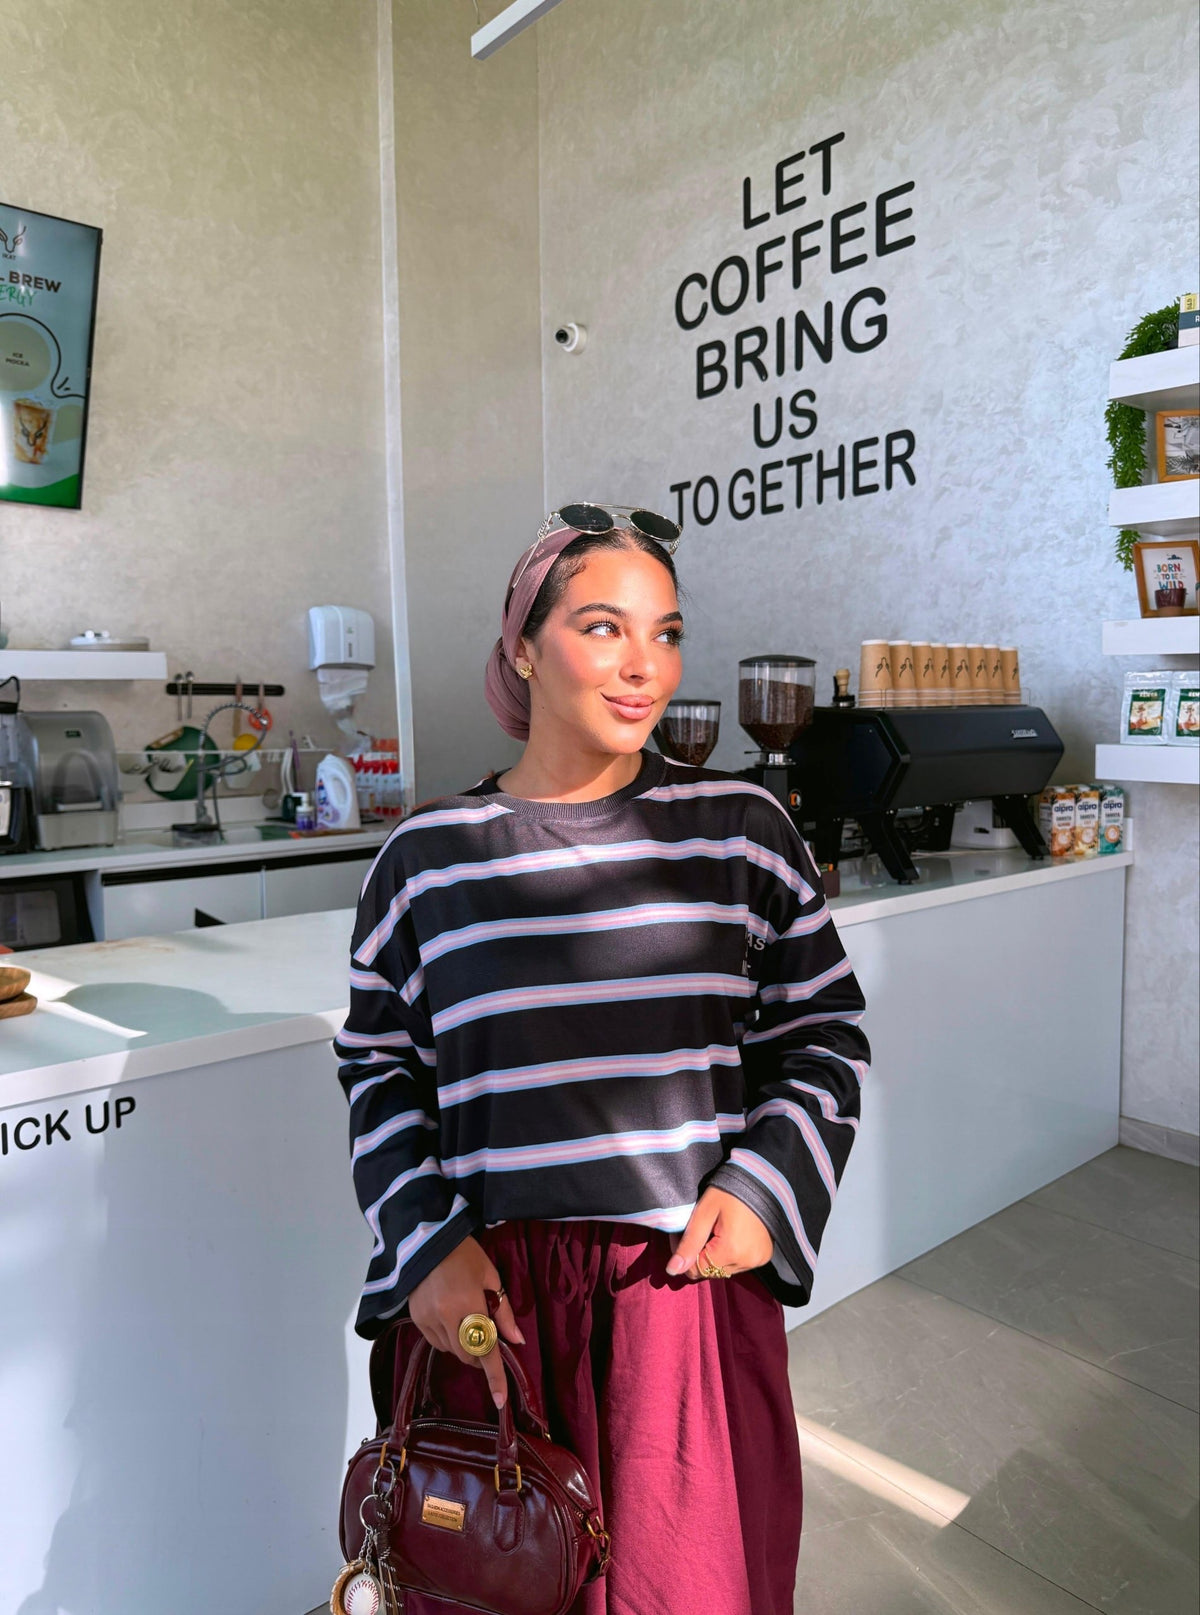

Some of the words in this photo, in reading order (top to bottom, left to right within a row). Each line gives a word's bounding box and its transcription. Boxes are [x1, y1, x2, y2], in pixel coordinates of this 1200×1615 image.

[742, 131, 845, 230] LET
[674, 180, 915, 331] COFFEE
[9, 270, 61, 293] BREW
[696, 287, 887, 400] BRING
[753, 389, 818, 449] US
[670, 429, 916, 526] TOGETHER
[1157, 563, 1181, 573] BORN
[1159, 581, 1184, 590] WILD
[1054, 803, 1074, 814] alpro
[1078, 801, 1097, 812] alpro
[1103, 800, 1122, 811] alpro
[1, 1109, 71, 1155] ICK
[85, 1096, 136, 1134] UP
